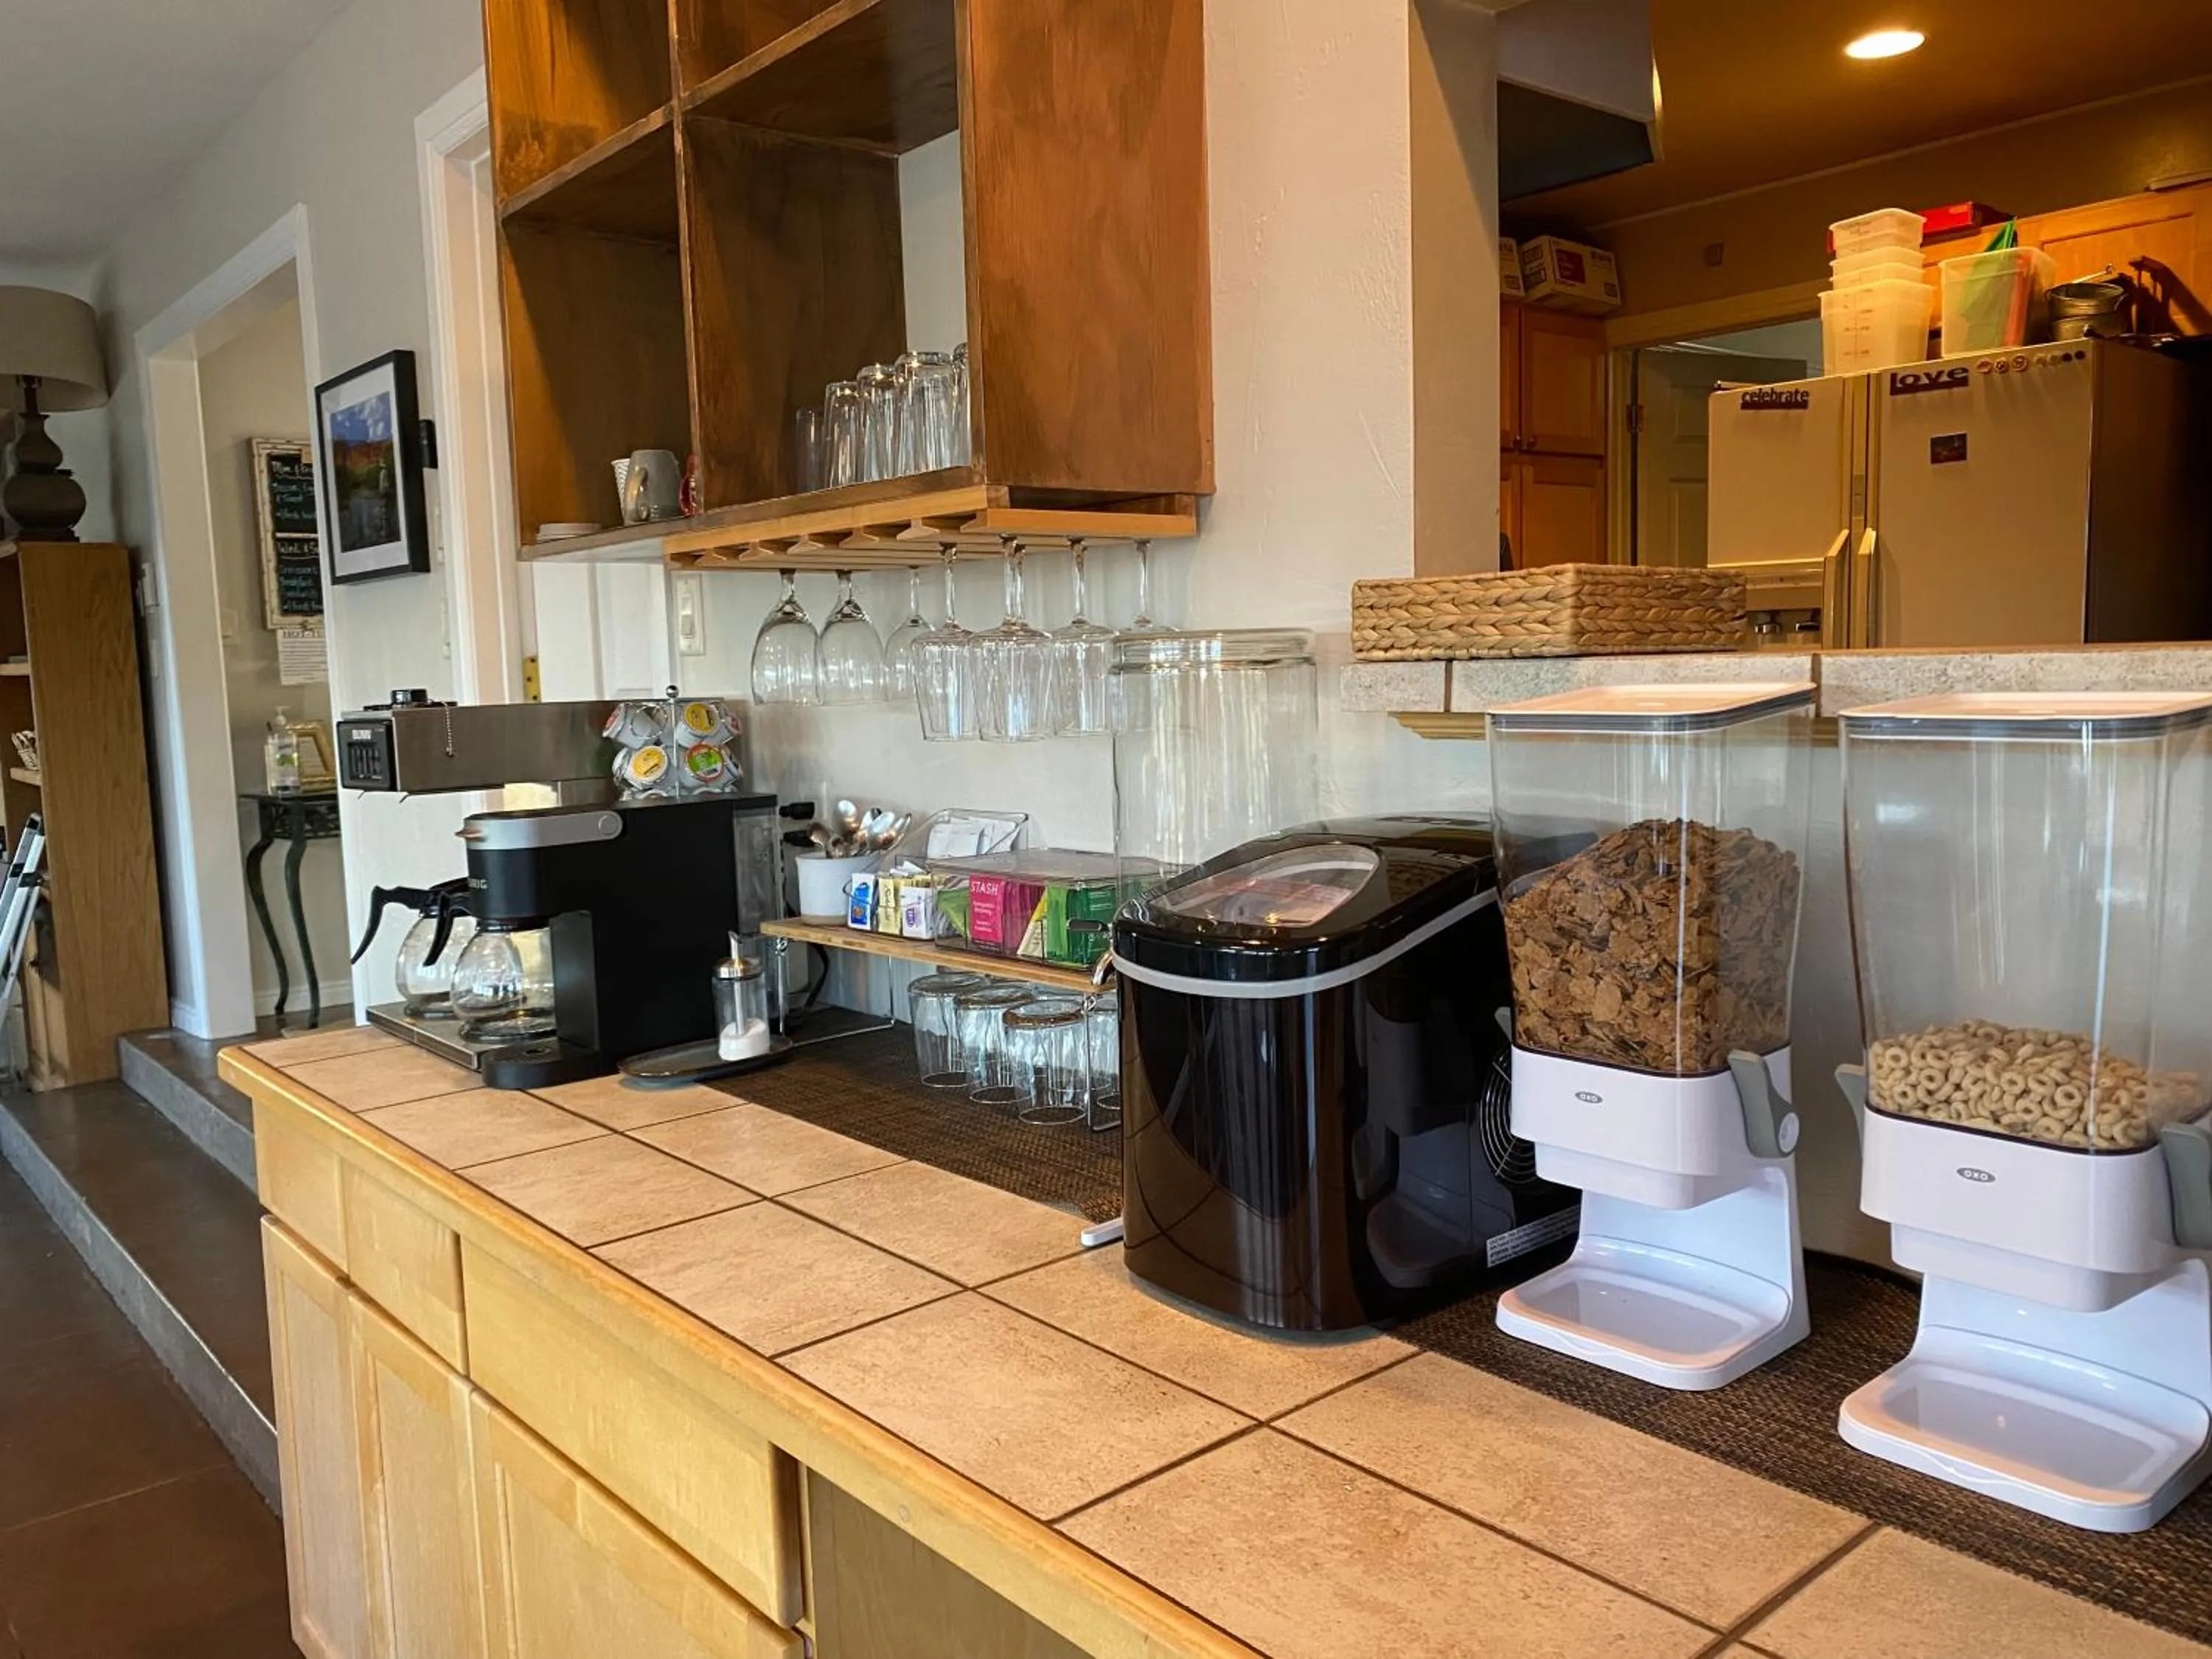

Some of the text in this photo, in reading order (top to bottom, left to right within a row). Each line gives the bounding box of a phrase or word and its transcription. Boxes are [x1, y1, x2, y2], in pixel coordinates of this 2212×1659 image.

[1890, 367, 1969, 392] love
[1741, 387, 1809, 405] celebrate
[971, 880, 998, 896] STASH
[1578, 1092, 1599, 1103] OXO
[1960, 1168, 1992, 1182] OXO
